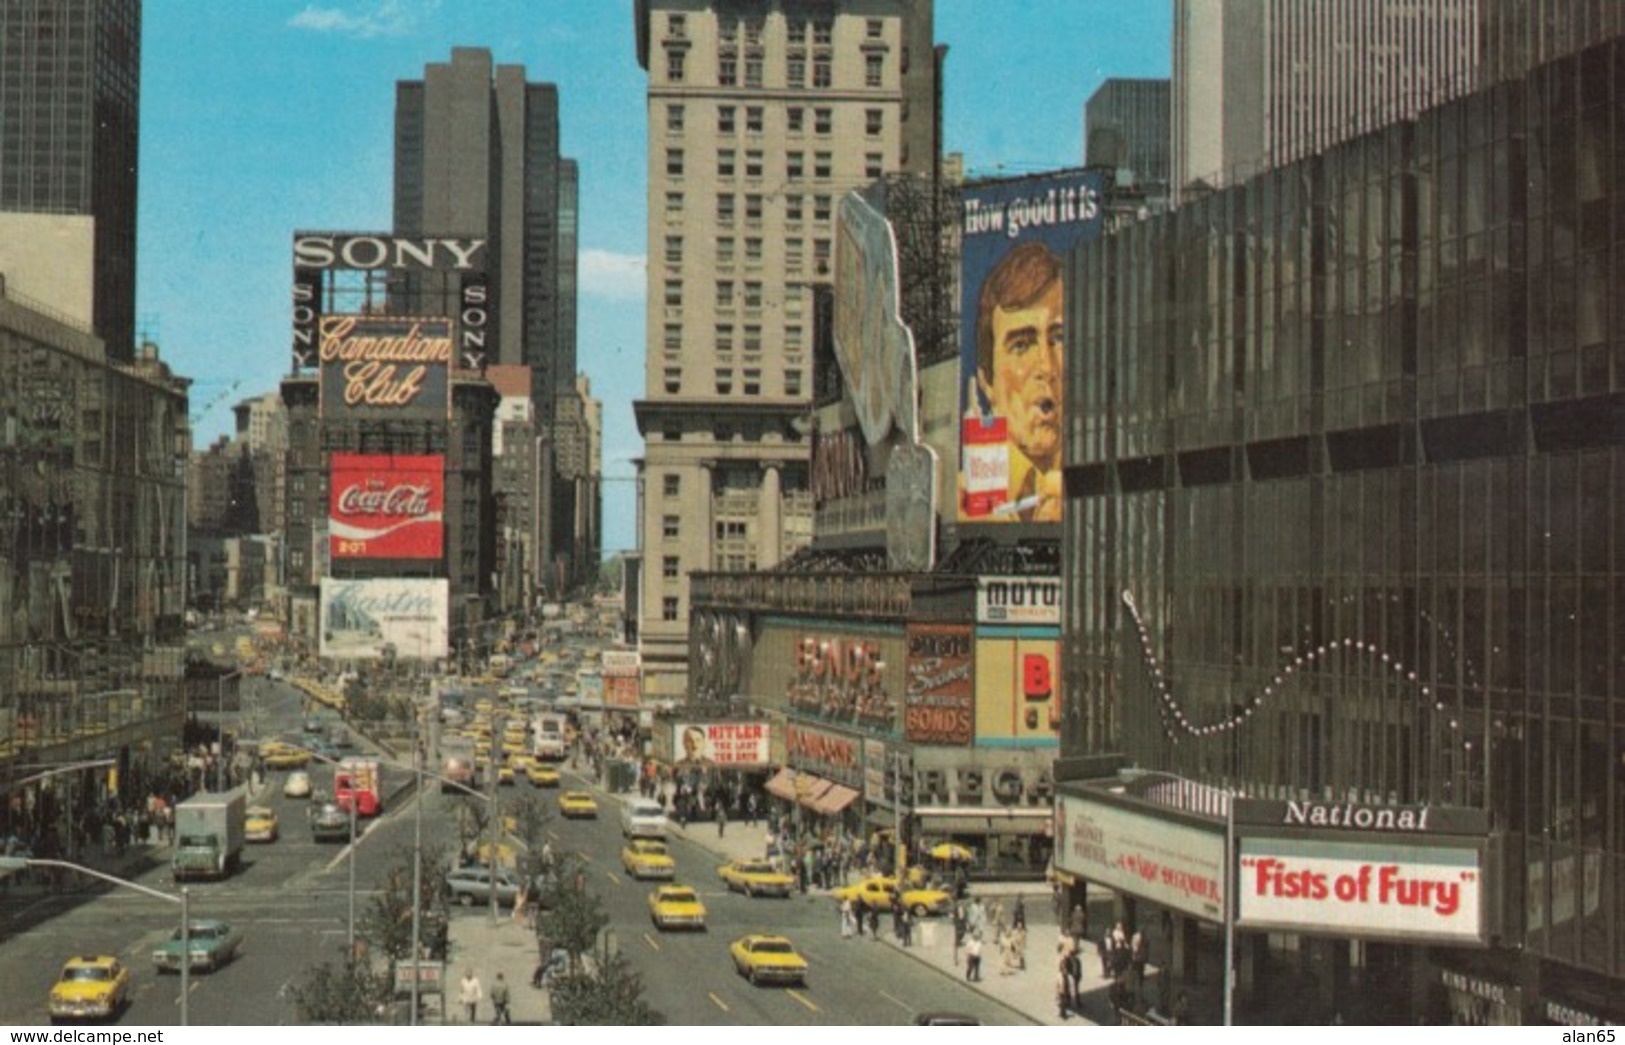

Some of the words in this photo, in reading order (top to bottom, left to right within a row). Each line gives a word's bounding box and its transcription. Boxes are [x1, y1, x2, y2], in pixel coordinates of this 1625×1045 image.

[965, 199, 1003, 233] How
[1008, 189, 1056, 238] good
[1059, 186, 1076, 222] it
[1078, 185, 1097, 220] is
[295, 237, 486, 269] SONY
[293, 284, 314, 368] SONY
[320, 317, 450, 361] Canadian
[462, 286, 487, 369] SONY
[343, 360, 427, 404] Club
[338, 484, 430, 516] Coca-Cola
[708, 724, 762, 740] HITLER
[907, 706, 971, 734] BONDS
[1284, 801, 1429, 830] National
[1334, 865, 1372, 902] of
